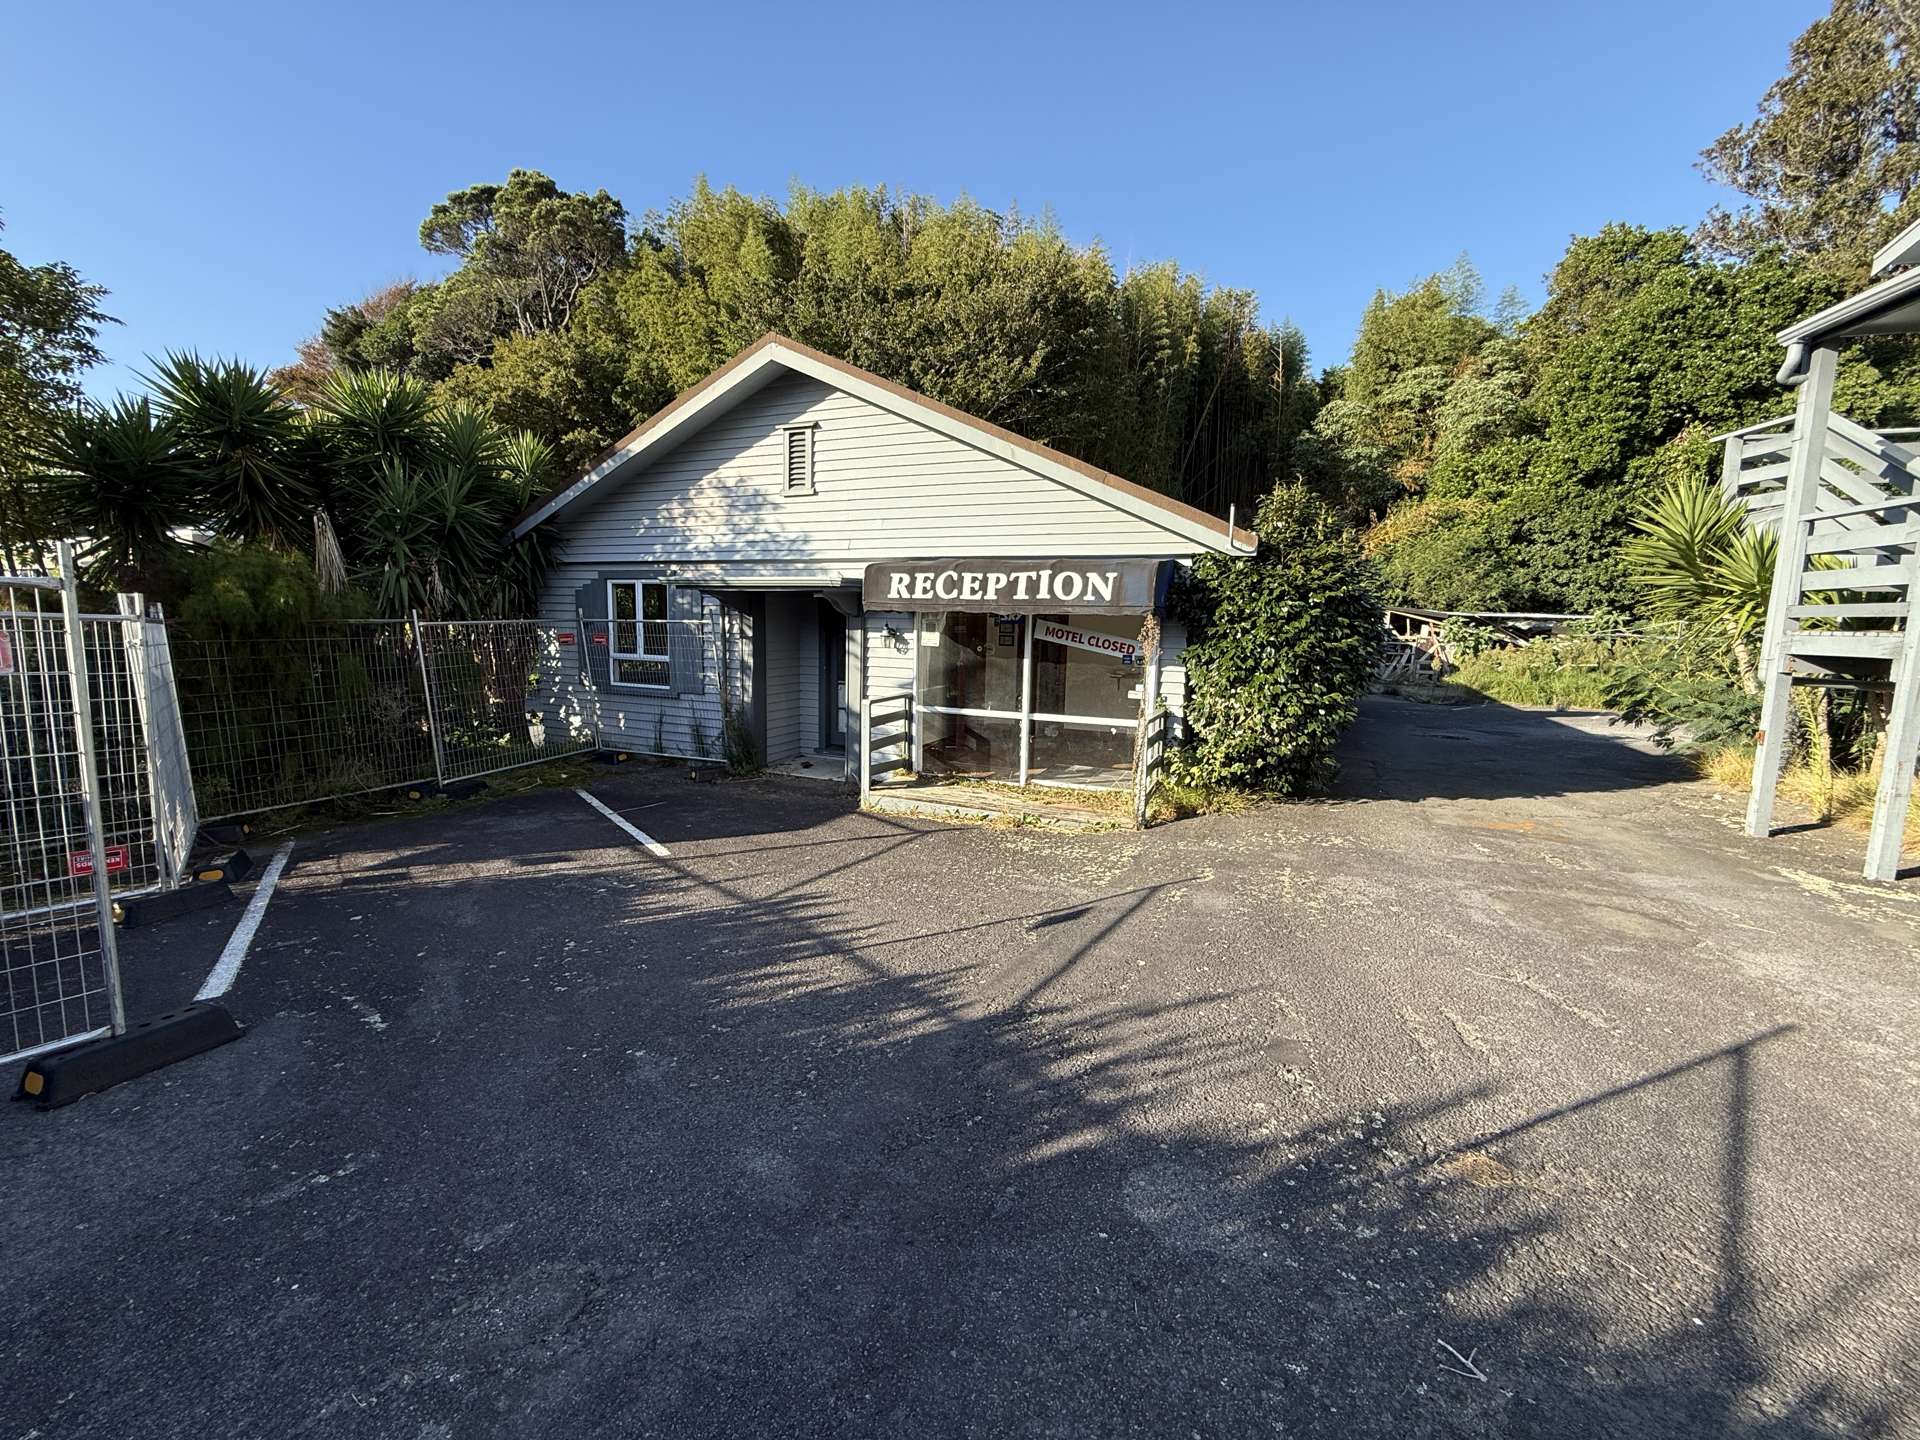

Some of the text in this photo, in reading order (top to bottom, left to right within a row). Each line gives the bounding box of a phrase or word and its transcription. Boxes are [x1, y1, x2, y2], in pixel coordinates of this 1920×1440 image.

[888, 570, 1118, 600] RECEPTION
[1045, 626, 1135, 655] MOTEL CLOSED
